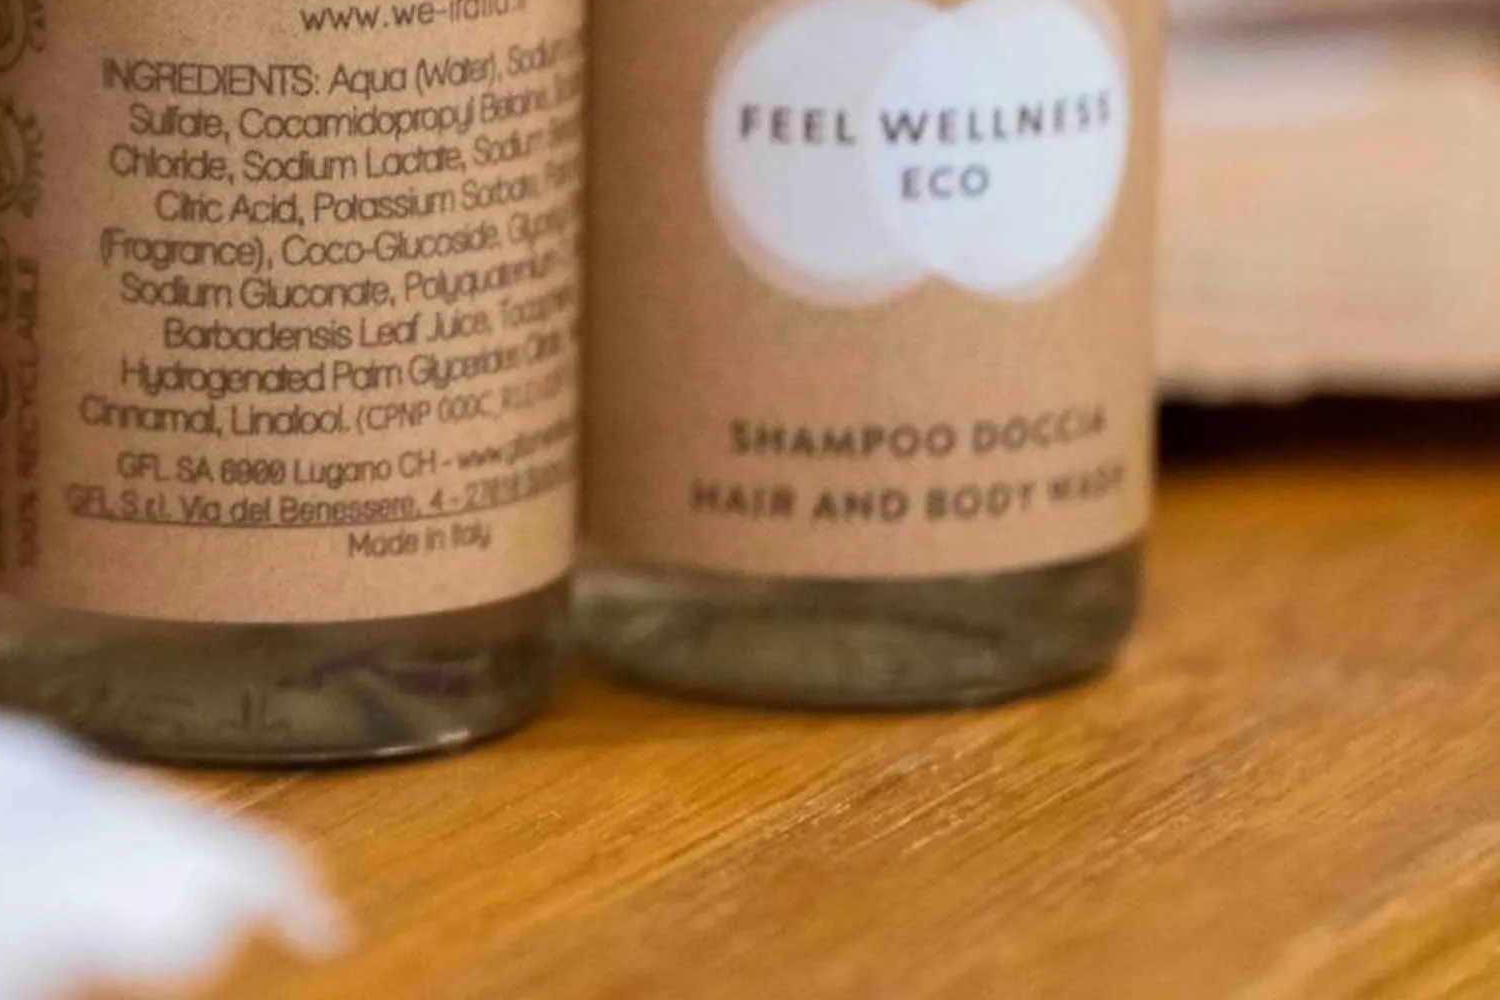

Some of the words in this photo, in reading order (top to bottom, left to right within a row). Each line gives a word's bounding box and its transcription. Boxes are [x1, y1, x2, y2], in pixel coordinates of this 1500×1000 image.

[102, 57, 321, 97] INGREDIENTS:
[329, 63, 407, 101] Aqua
[129, 102, 230, 143] Sulfate,
[239, 95, 475, 142] Cocamidopropyl
[739, 103, 858, 146] FEEL
[879, 89, 1112, 145] WELLNESS
[109, 142, 235, 186] Chloride,
[243, 149, 357, 182] Sodium
[366, 147, 467, 180] Lactate,
[901, 163, 991, 201] ECO
[155, 189, 224, 224] Citric
[231, 193, 306, 227] Acid,
[313, 186, 456, 223] Potassium
[100, 227, 274, 274] (Fragrance),
[120, 271, 233, 309] Sodium
[240, 275, 396, 310] Gluconate,
[164, 317, 354, 350] Barbadensis
[359, 311, 422, 348] Leaf
[120, 354, 326, 400] Hydrogenated
[333, 359, 403, 392] Palm
[81, 394, 224, 438] Cinnamal,
[356, 400, 431, 435] (CPNP
[729, 418, 957, 459] SHAMPOO
[116, 451, 171, 482] GFL
[176, 455, 215, 484] SA
[293, 458, 392, 490] Lugano
[399, 448, 437, 479] CH
[180, 496, 221, 523] Via
[228, 495, 271, 522] del
[691, 476, 795, 520] HAIR
[812, 484, 910, 522] AND
[924, 480, 1036, 521] BODY
[349, 531, 418, 559] Made
